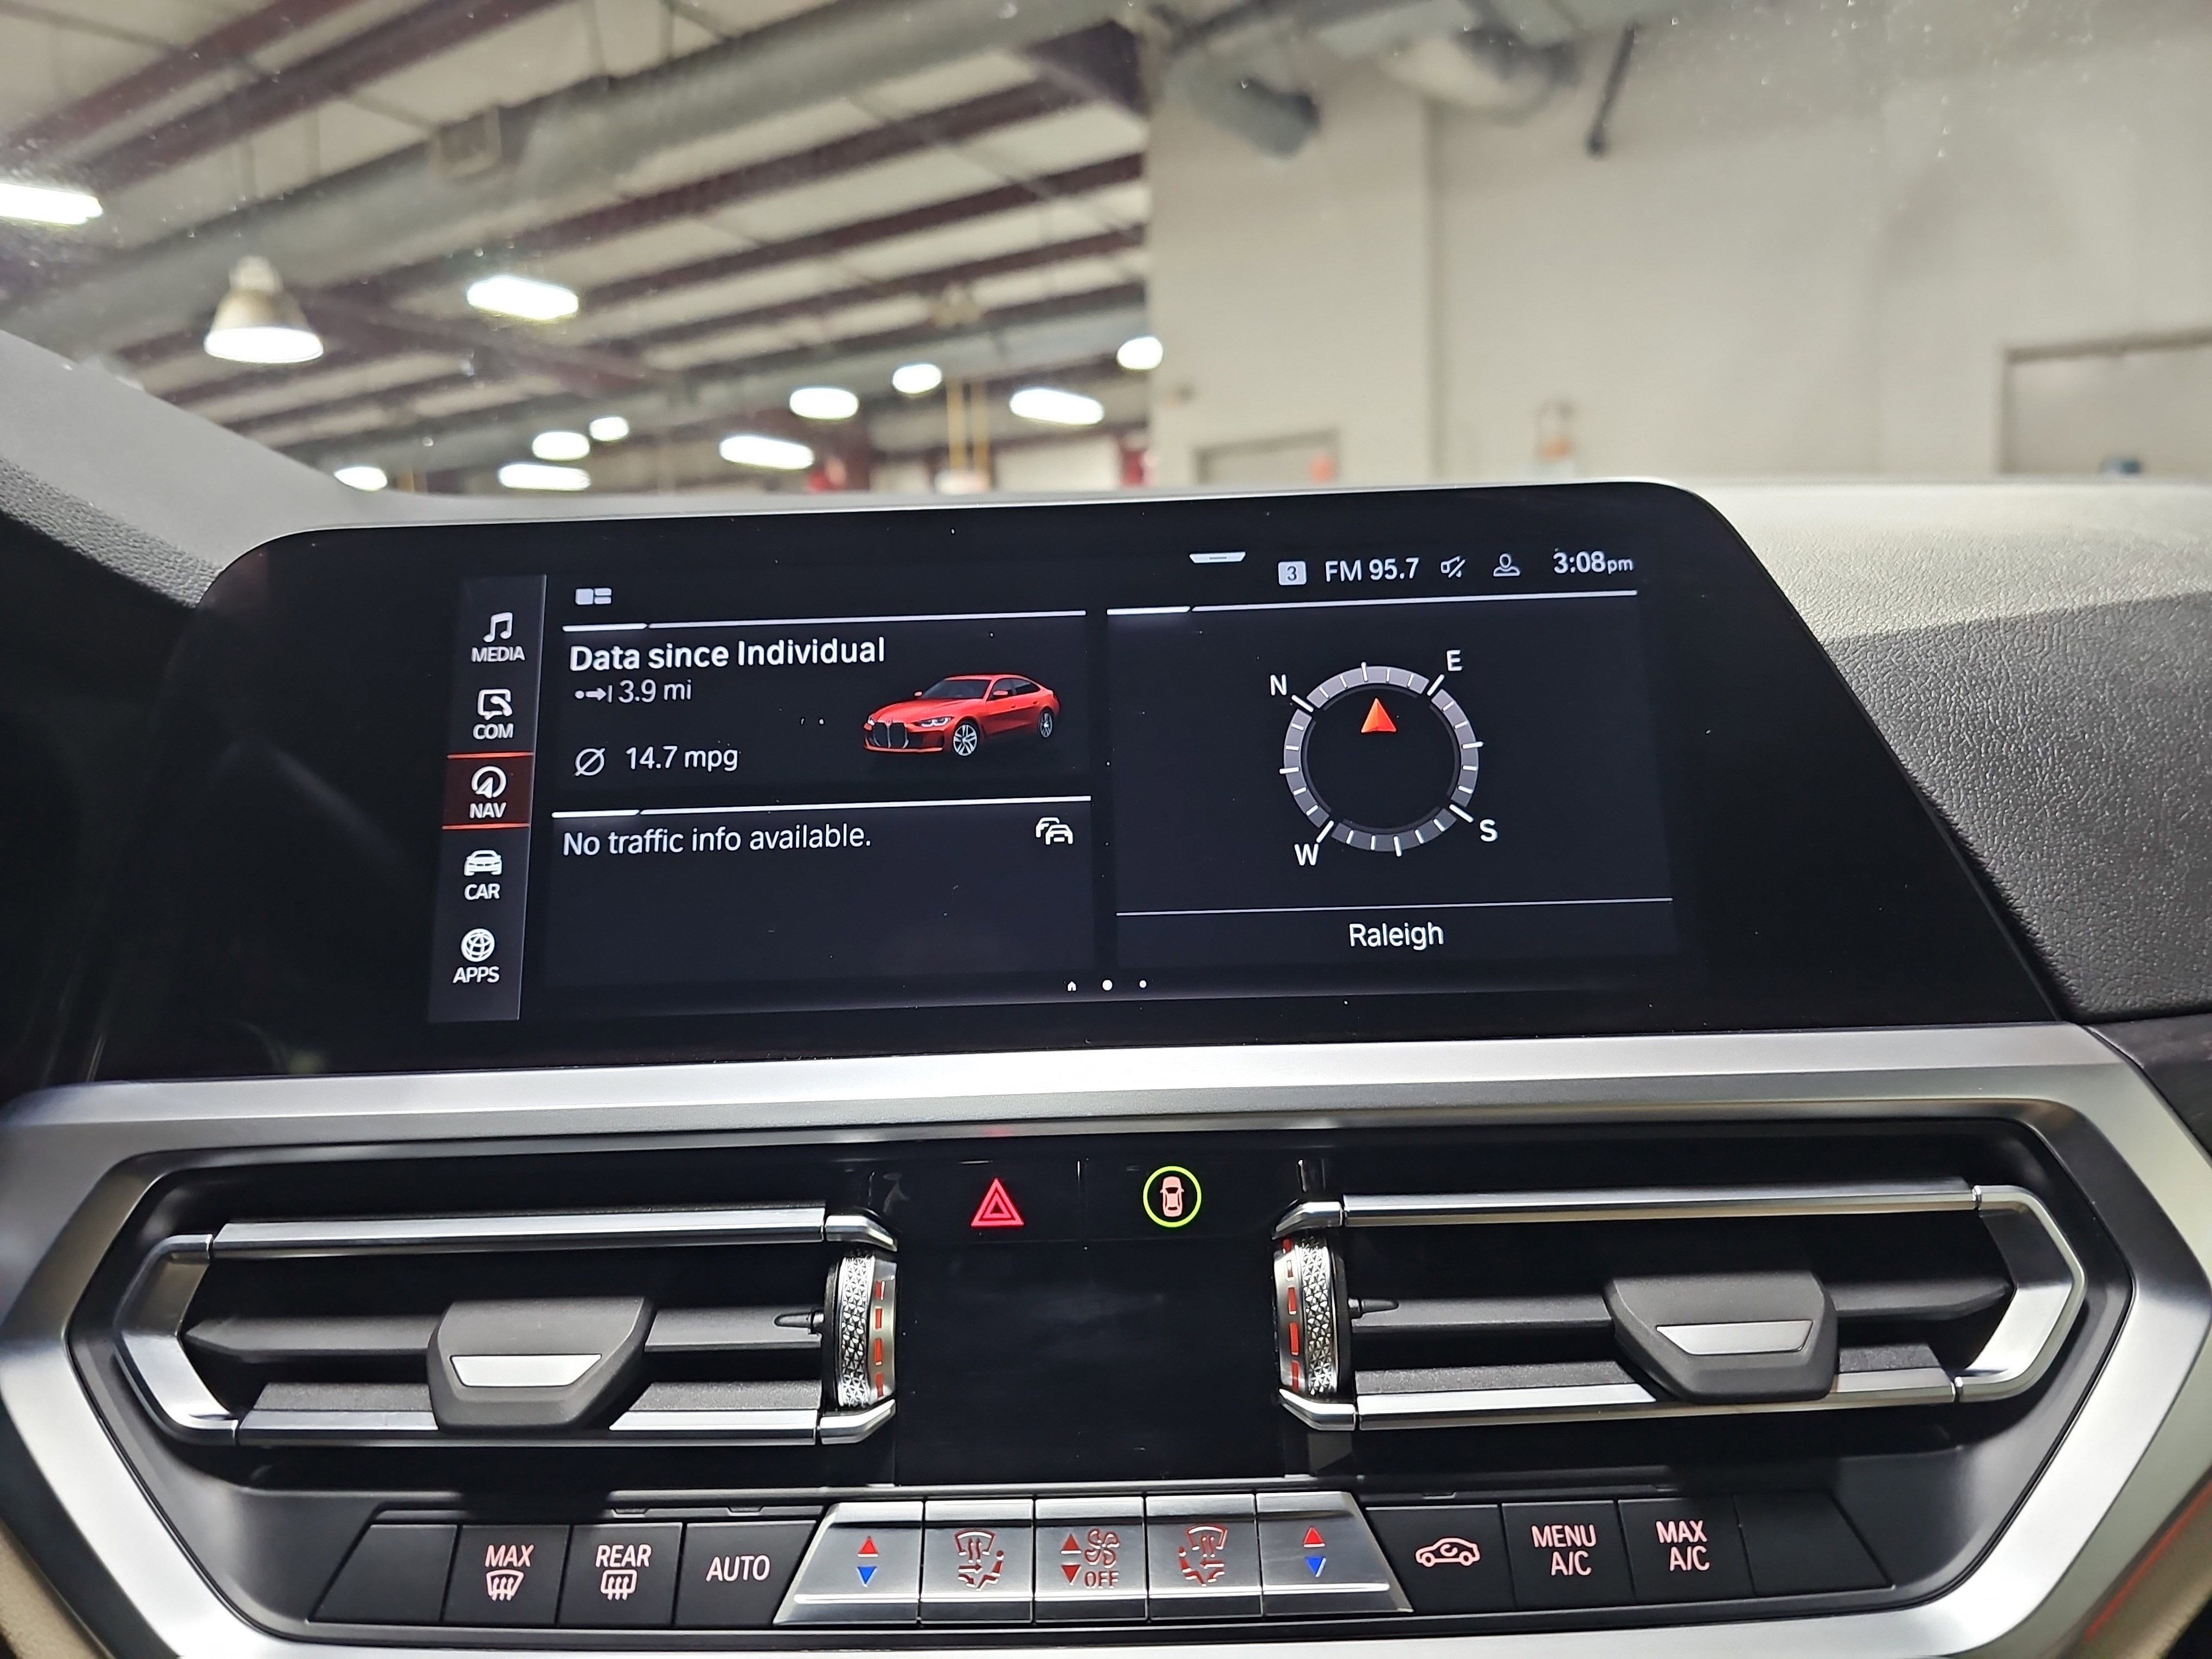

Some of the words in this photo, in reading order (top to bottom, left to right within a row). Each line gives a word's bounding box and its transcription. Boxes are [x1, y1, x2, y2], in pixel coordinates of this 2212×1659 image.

[1286, 565, 1297, 581] 3
[1324, 559, 1362, 583] FM
[1368, 557, 1420, 581] 95.7
[471, 645, 526, 663] MEDIA
[569, 645, 640, 672] Data
[647, 642, 730, 670] since
[737, 636, 885, 666] Individual
[1446, 649, 1463, 672] E
[618, 678, 657, 704] 3.9
[663, 678, 692, 701] mi
[1269, 673, 1288, 696] N
[472, 722, 515, 740] COM
[625, 745, 678, 770] 14.7
[684, 749, 738, 773] mpg
[469, 801, 507, 819] NAV
[563, 831, 601, 857] No
[607, 827, 684, 854] traffic
[691, 826, 742, 852] info
[749, 822, 871, 851] available.
[1479, 818, 1499, 843] S
[1294, 843, 1320, 866] W
[464, 883, 501, 901] CAR
[1348, 921, 1444, 951] Raleigh
[452, 965, 500, 984] APPS
[1531, 1523, 1597, 1548] MENU
[1655, 1520, 1708, 1544] MAX
[484, 1544, 535, 1568] MAX
[595, 1544, 652, 1568] REAR
[1551, 1549, 1592, 1577] A/C
[1669, 1545, 1711, 1572] A/C
[705, 1554, 771, 1583] AUTO
[1084, 1571, 1120, 1590] OFF
